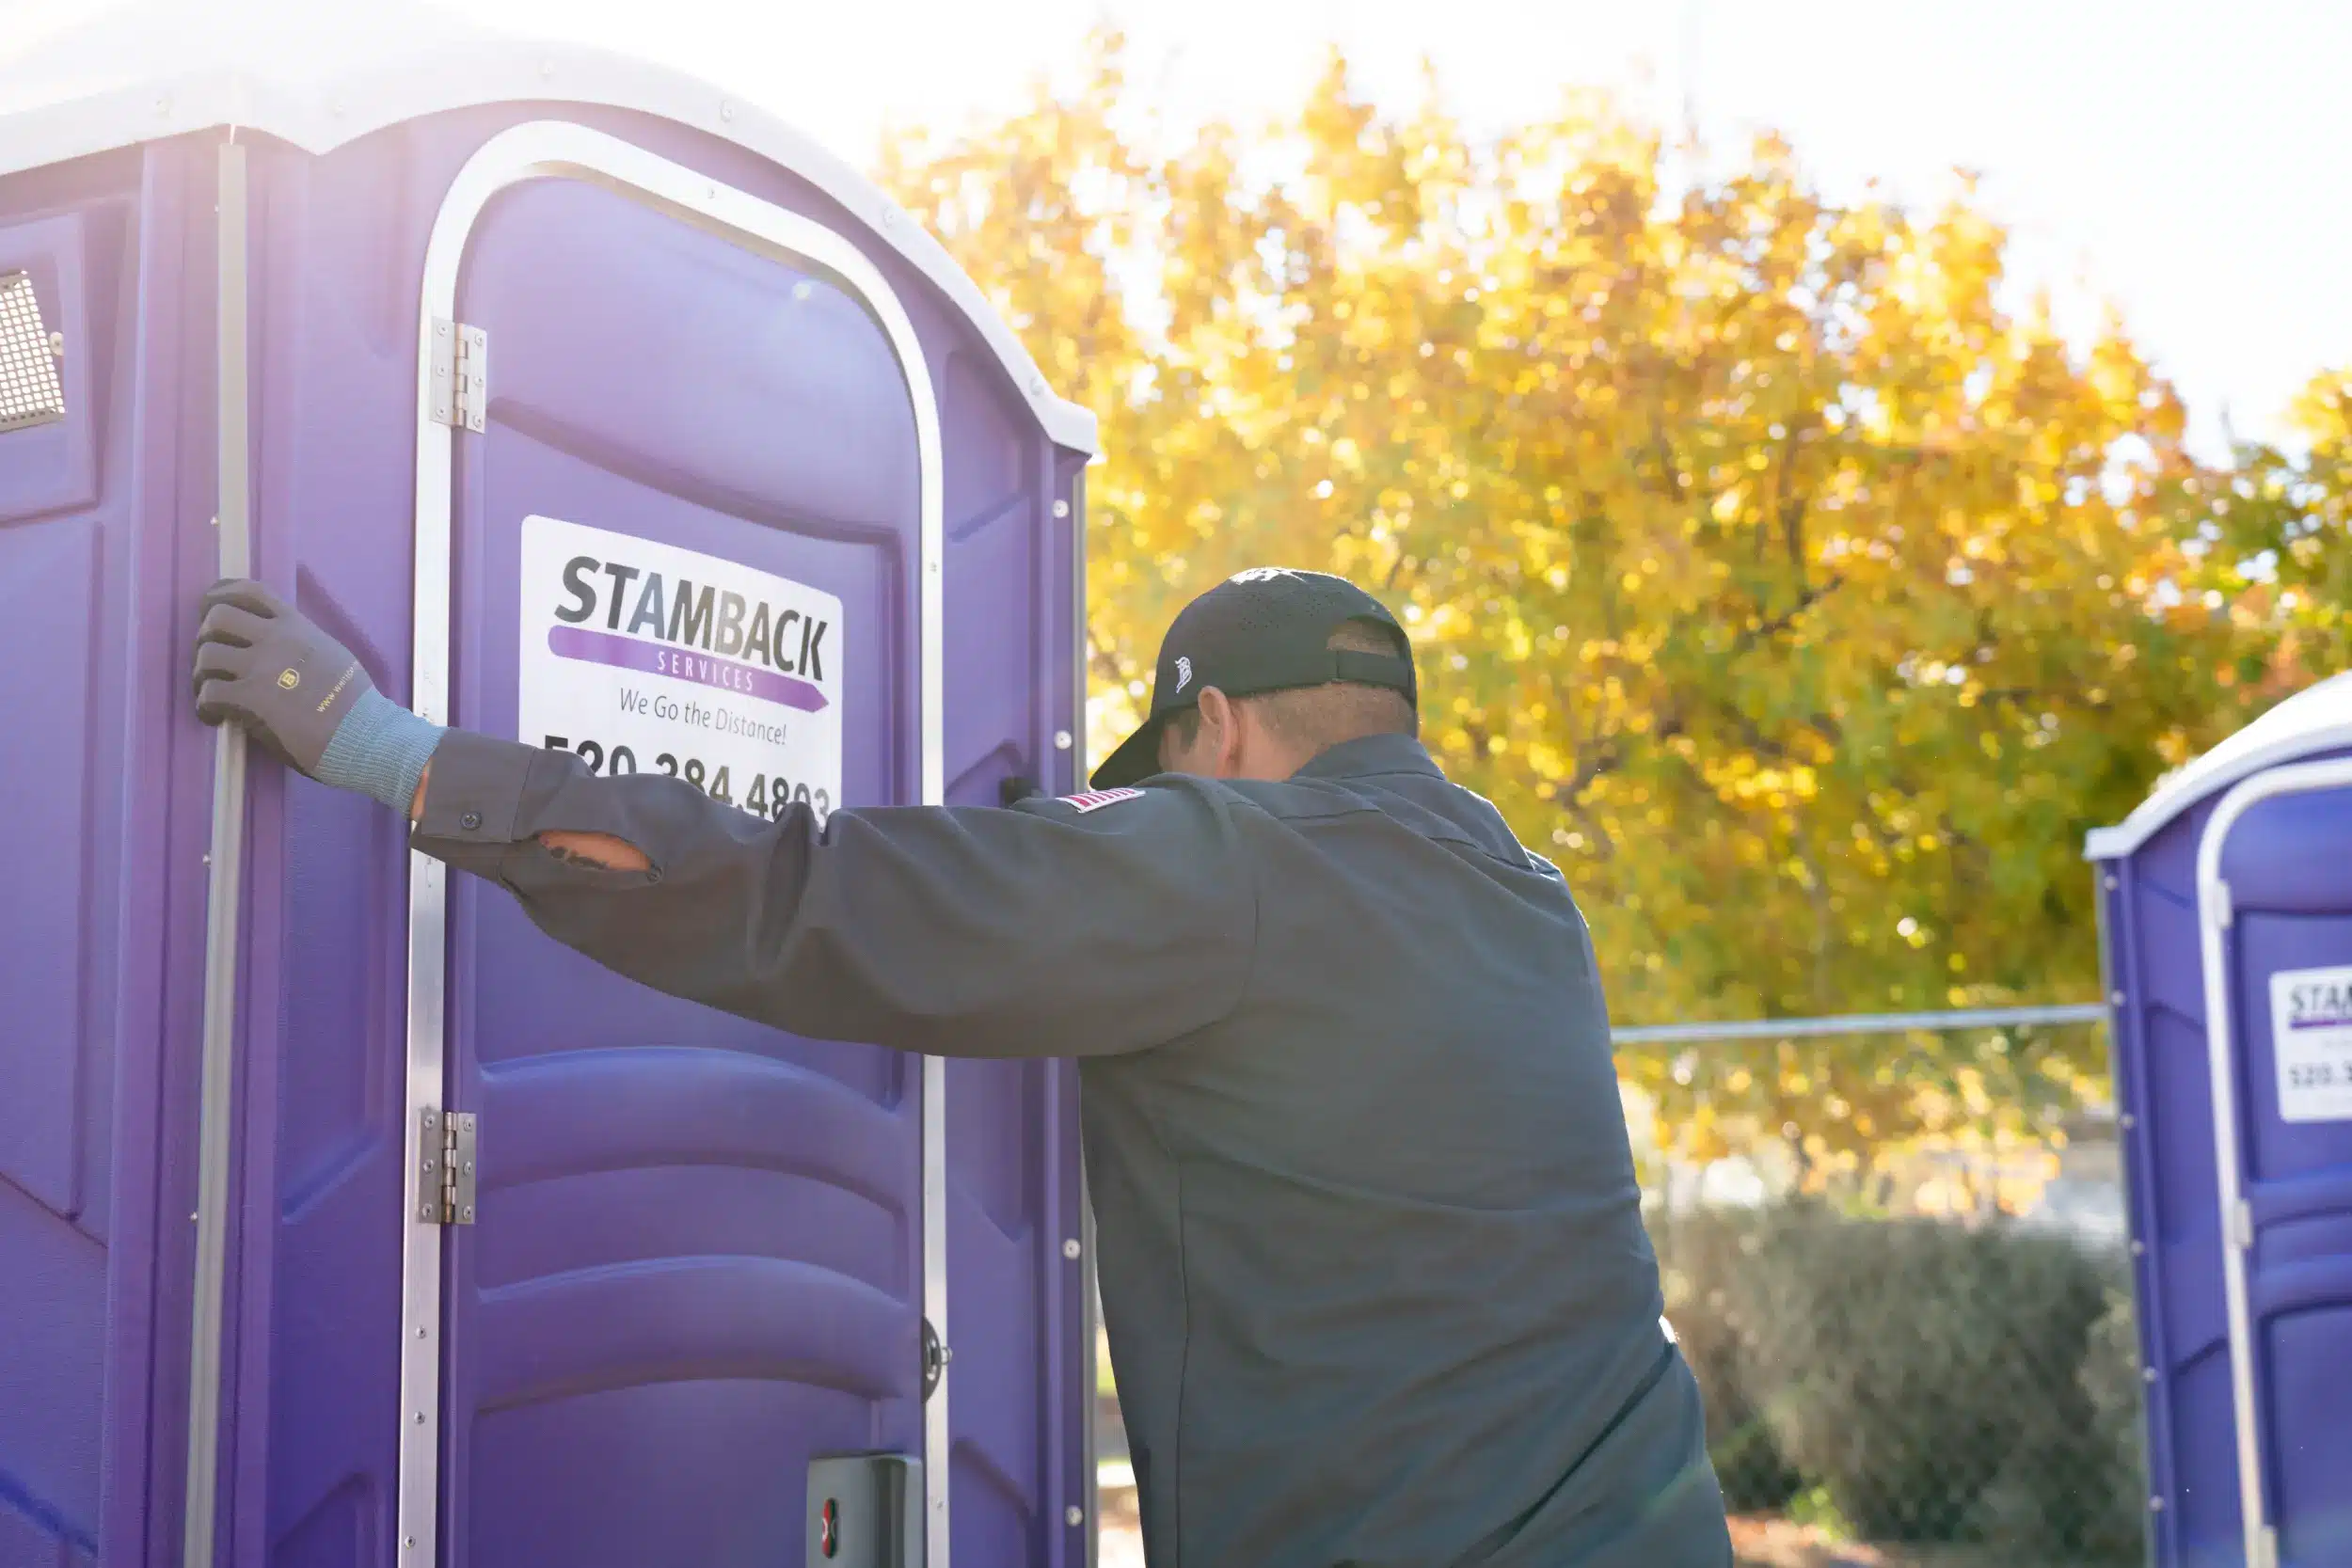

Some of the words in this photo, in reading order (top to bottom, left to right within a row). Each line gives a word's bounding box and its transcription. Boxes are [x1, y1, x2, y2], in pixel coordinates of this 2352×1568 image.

[553, 555, 828, 681] STAMBACK
[657, 651, 754, 691] SERVICES
[620, 688, 648, 715] We
[654, 695, 678, 721] Go
[684, 702, 710, 728] the
[715, 707, 787, 745] Distance!
